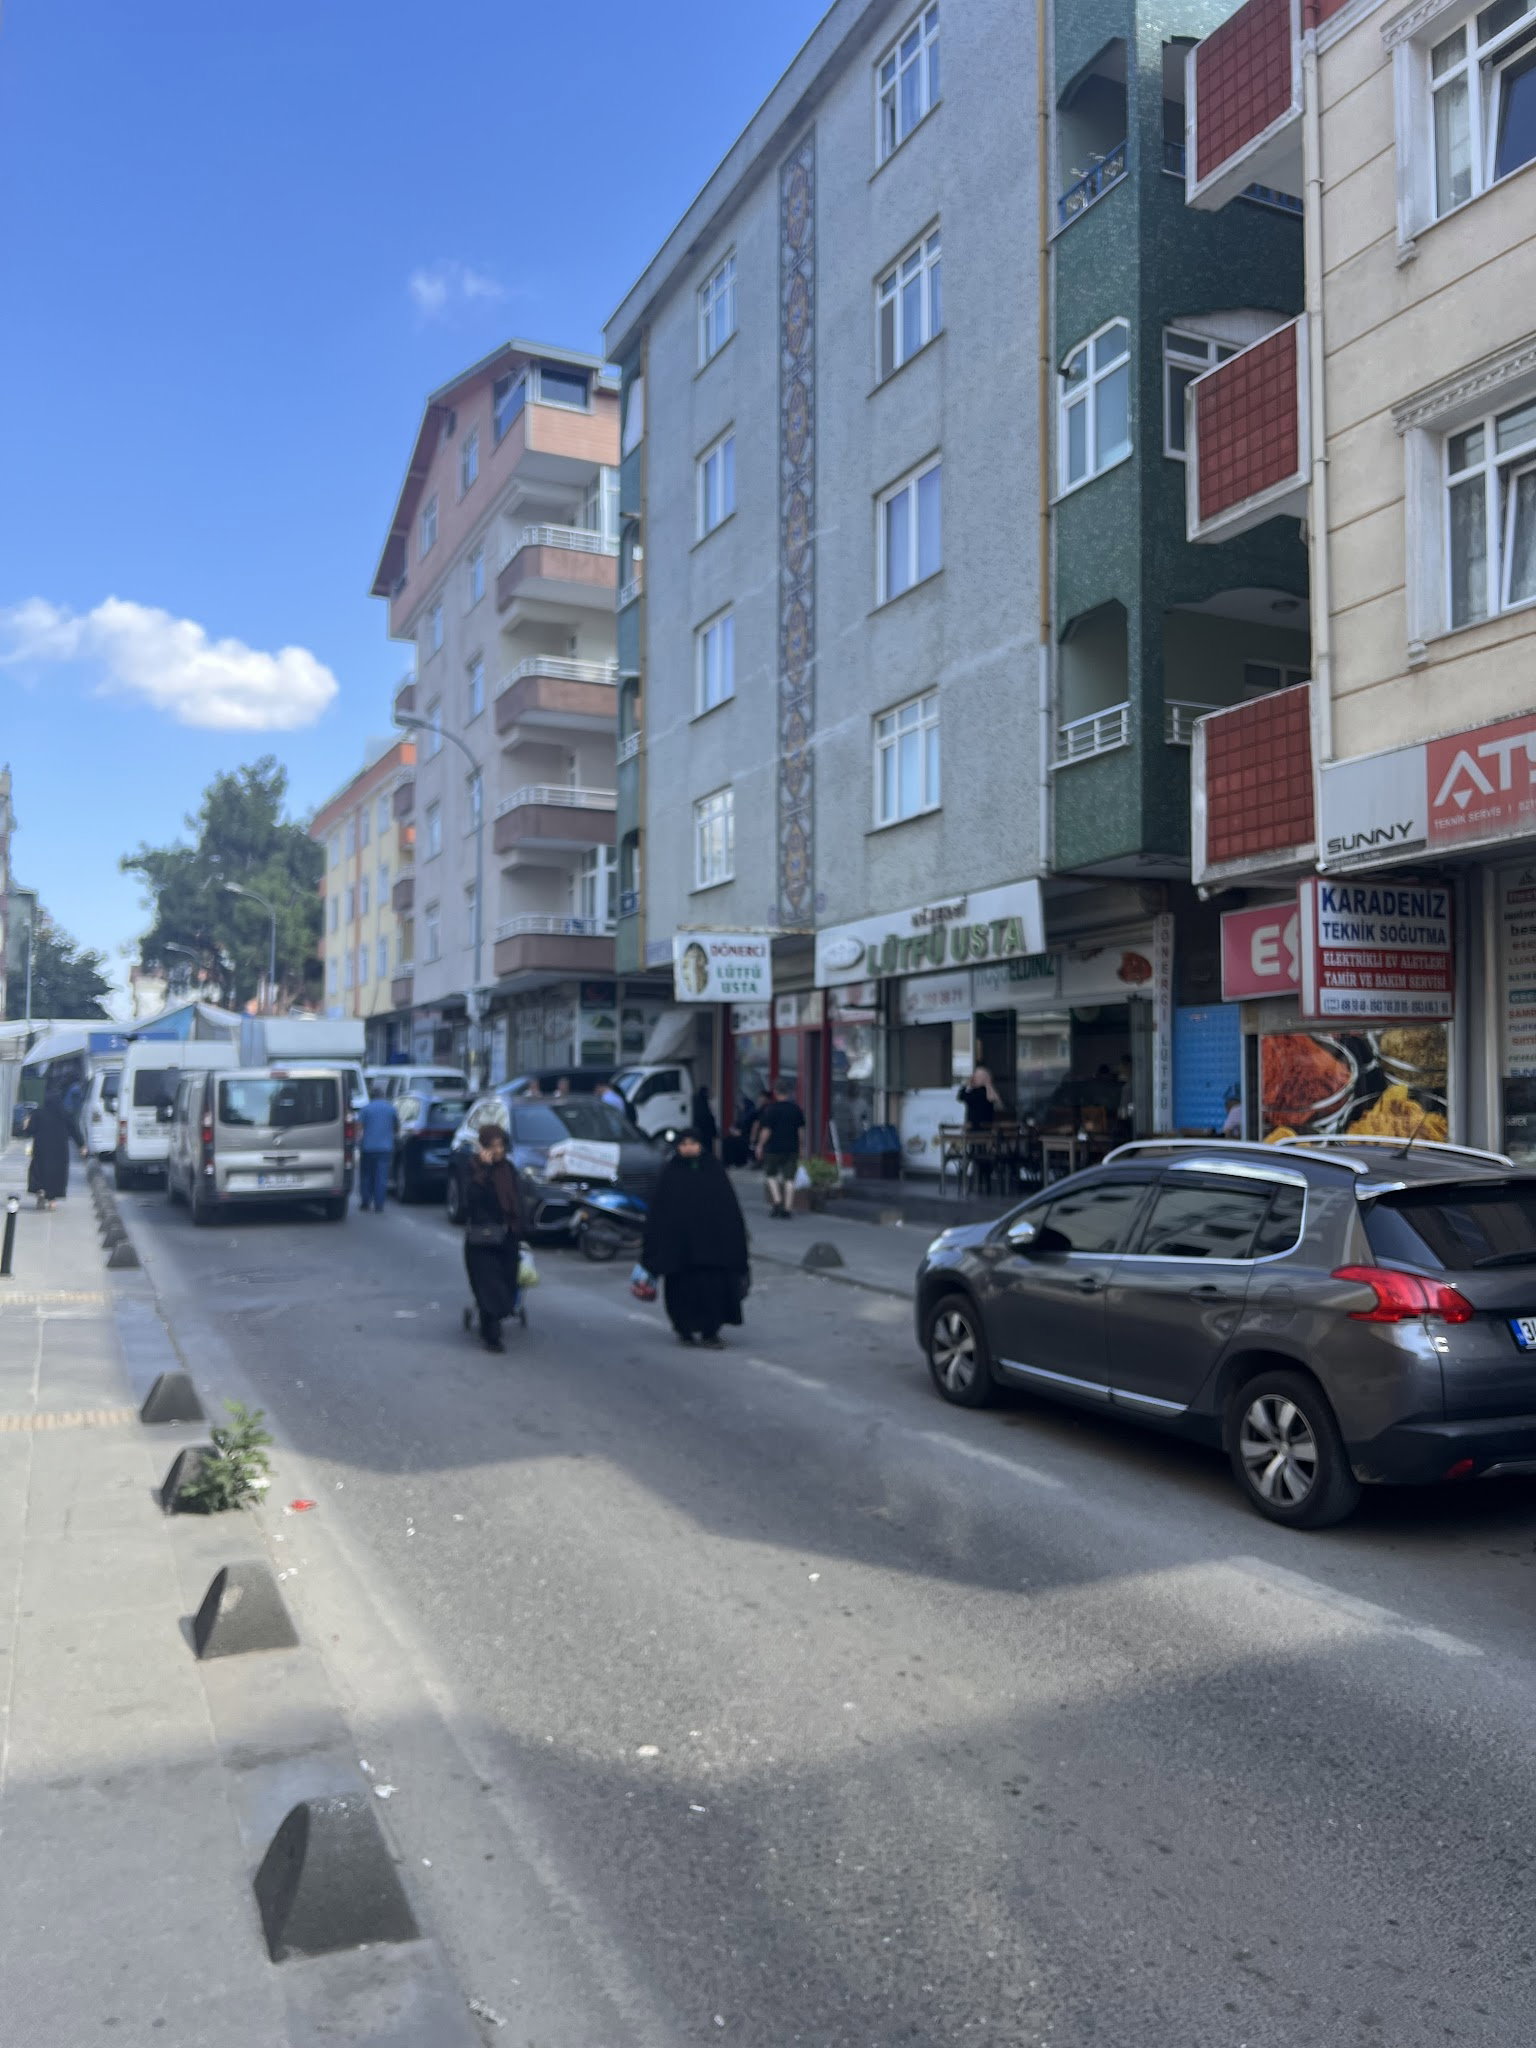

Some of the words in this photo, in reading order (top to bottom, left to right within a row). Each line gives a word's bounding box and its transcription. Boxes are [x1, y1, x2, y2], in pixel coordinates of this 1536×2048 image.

[1327, 820, 1414, 855] SUNNY
[1321, 887, 1446, 919] KARADENİZ
[1322, 921, 1376, 942] TEKNİK
[1380, 924, 1446, 944] SOĞUTMA
[711, 942, 766, 957] DÖNERCİ
[866, 924, 947, 977] LÜTFÜ
[950, 917, 1027, 962] USTA
[1323, 951, 1382, 968] ELEKTRİKLİ
[1385, 953, 1398, 969] EV
[721, 982, 758, 994] USTA
[1324, 969, 1357, 987] TAMİR
[1360, 973, 1373, 988] VE
[1375, 973, 1407, 989] BAKIM
[1409, 973, 1447, 990] SERVİSİ
